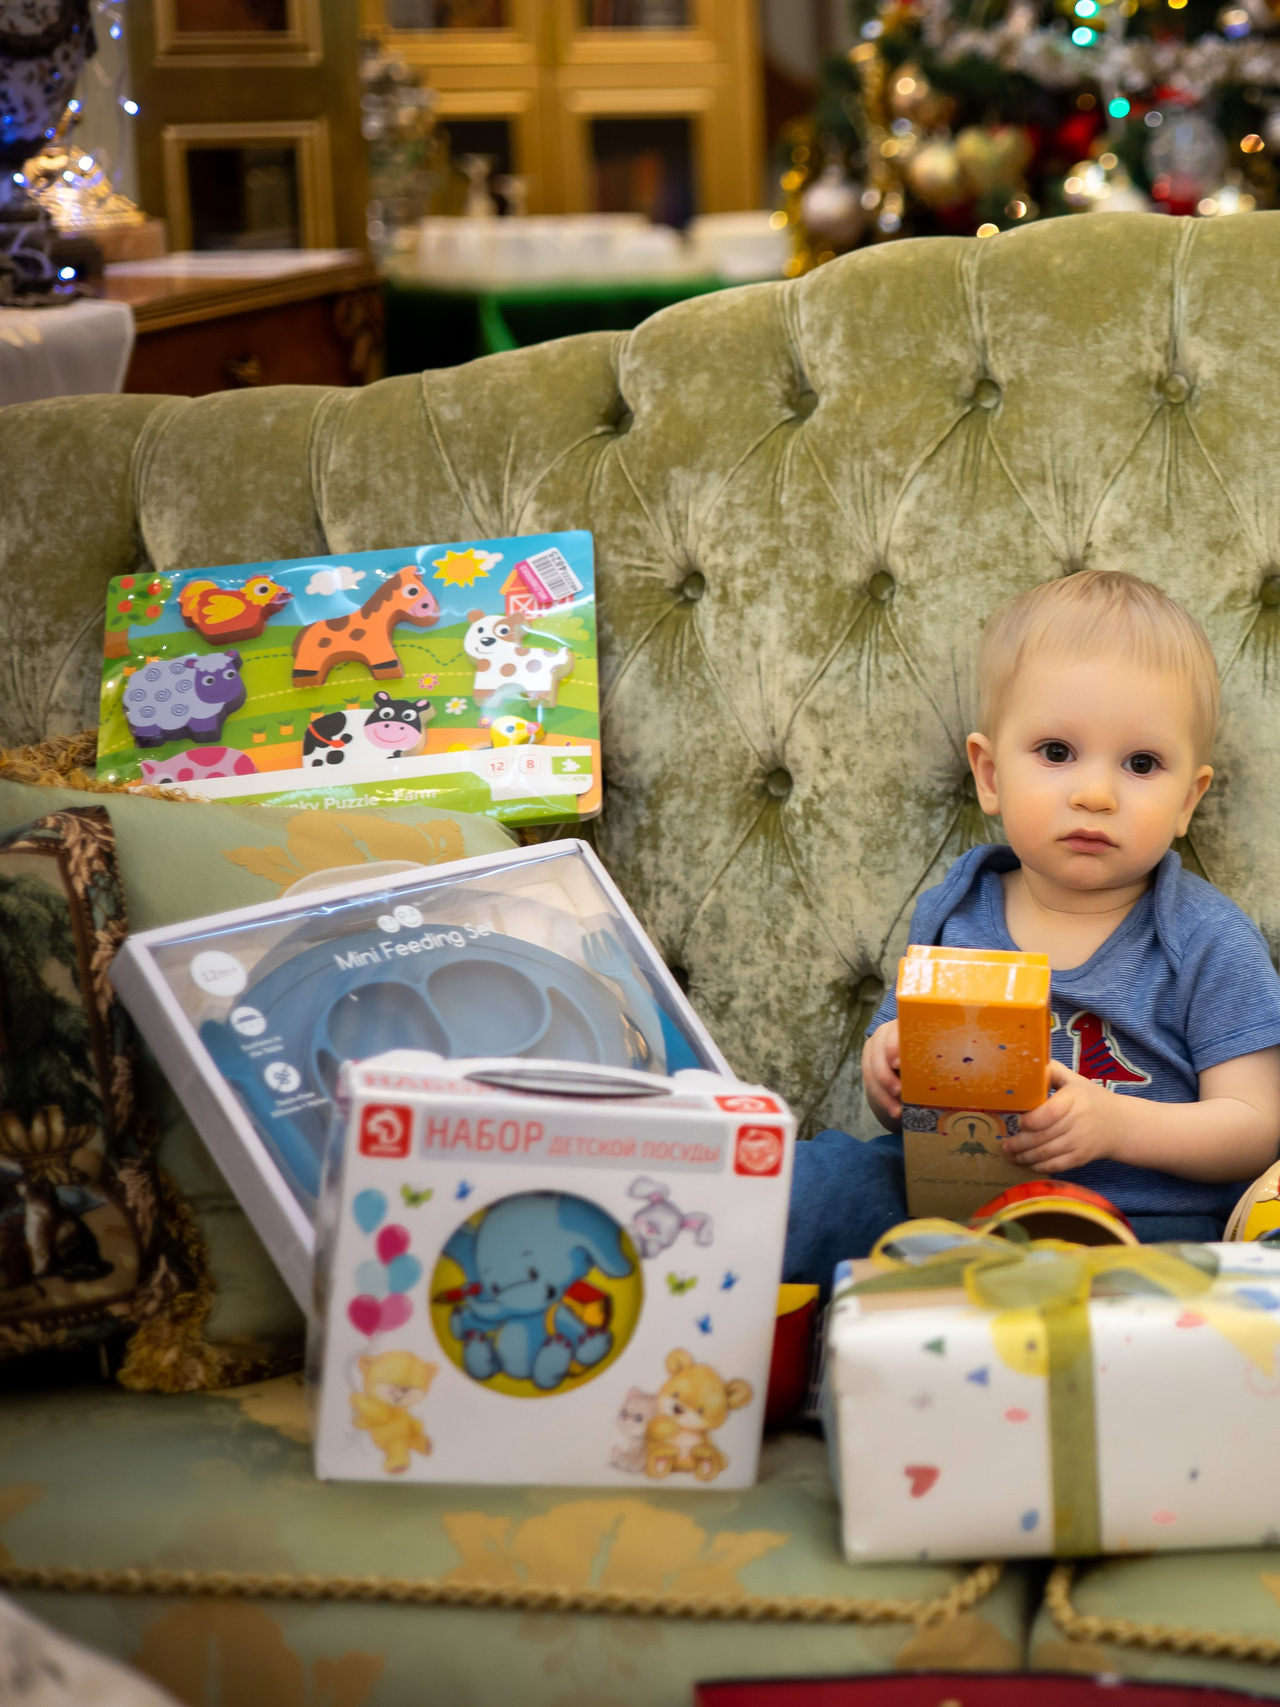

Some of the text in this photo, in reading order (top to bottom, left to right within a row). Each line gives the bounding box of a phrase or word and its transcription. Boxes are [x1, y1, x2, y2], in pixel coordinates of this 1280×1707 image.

[490, 762, 504, 771] 12
[526, 760, 535, 769] 8
[324, 794, 379, 810] Puzzle
[393, 788, 437, 803] Farm
[333, 920, 495, 971] Mini Feeding Set
[424, 1116, 545, 1155] НАБОР
[548, 1135, 637, 1159] ДЕТСКОЙ
[640, 1139, 722, 1163] ПОСУДЫ
